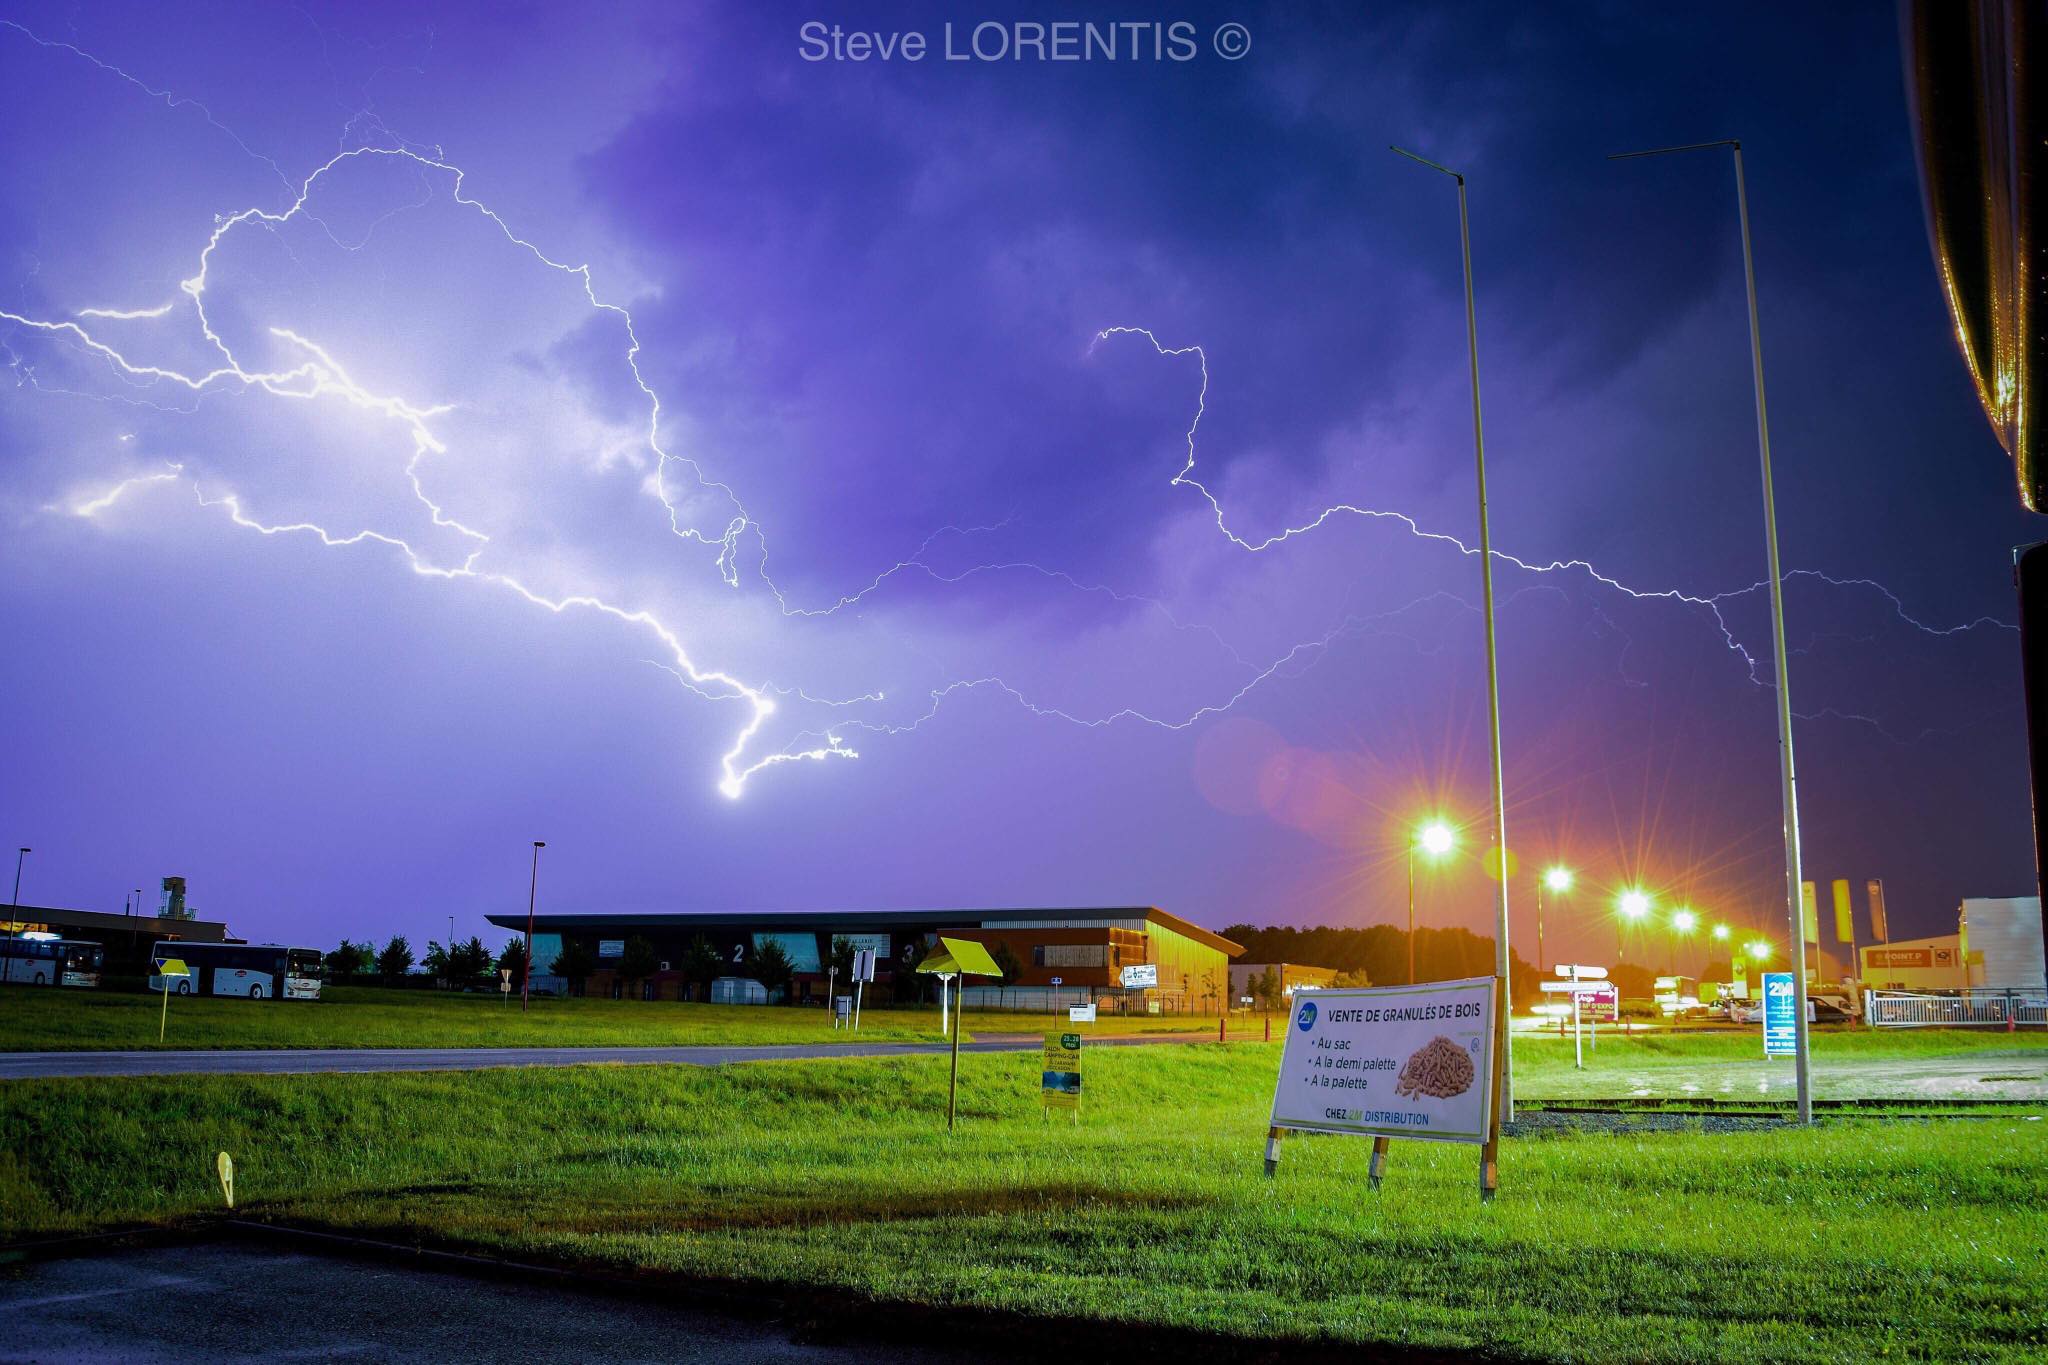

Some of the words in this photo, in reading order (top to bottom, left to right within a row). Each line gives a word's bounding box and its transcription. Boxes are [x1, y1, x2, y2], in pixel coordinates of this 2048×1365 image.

[732, 943, 745, 963] 2
[1328, 1009, 1363, 1023] VENTE
[1365, 1008, 1380, 1022] DE
[1382, 1003, 1437, 1022] GRANULÉS
[1438, 1004, 1453, 1019] DE
[1455, 1002, 1481, 1018] BOIS
[1317, 1036, 1332, 1050] Au
[1334, 1039, 1351, 1050] sac
[1314, 1057, 1323, 1068] A
[1325, 1057, 1335, 1068] la
[1337, 1056, 1361, 1069] demi
[1363, 1057, 1396, 1072] palette
[1310, 1076, 1319, 1087] A
[1321, 1075, 1330, 1087] la
[1331, 1076, 1368, 1091] palette
[1325, 1107, 1347, 1119] CHEZ
[1347, 1109, 1363, 1121] 2M
[1364, 1110, 1429, 1126] DISTRIBUTION
